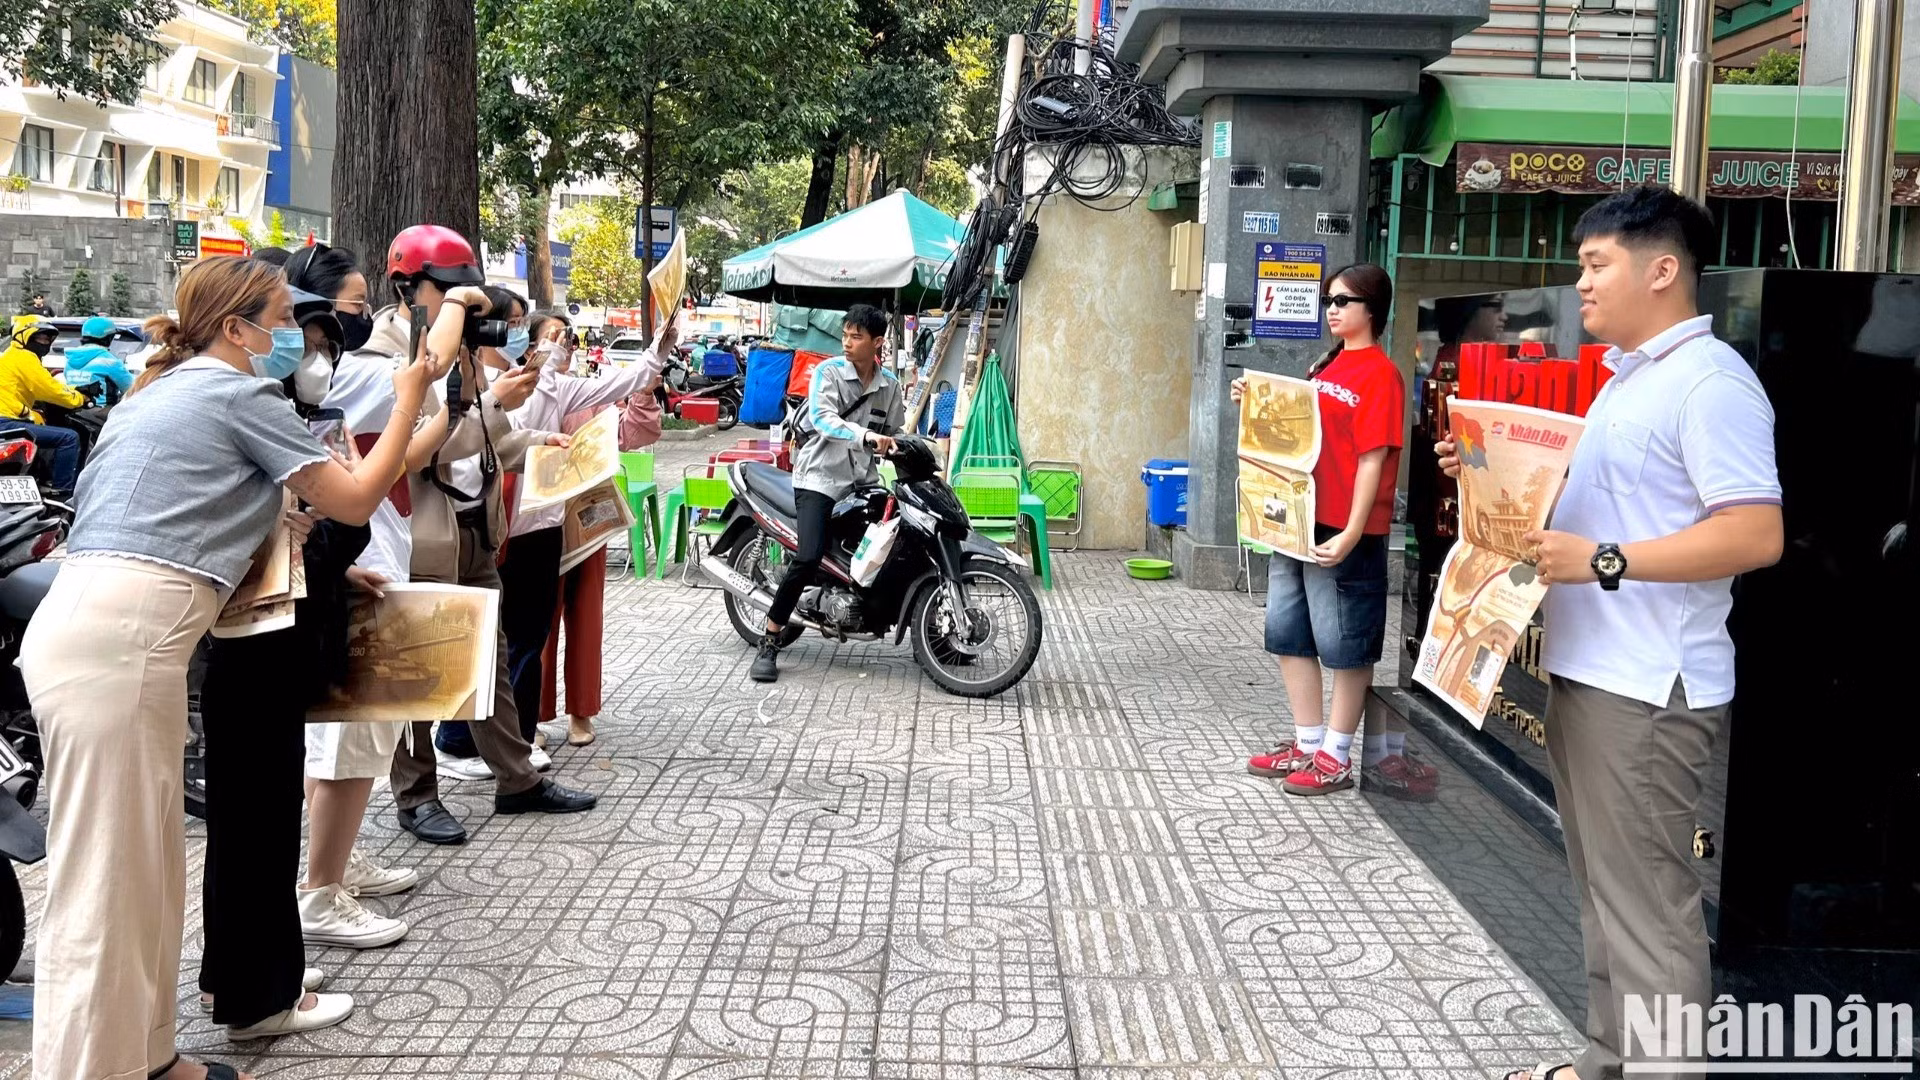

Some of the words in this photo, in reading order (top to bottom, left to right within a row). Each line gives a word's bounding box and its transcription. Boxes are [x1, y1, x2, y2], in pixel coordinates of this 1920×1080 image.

[1520, 173, 1544, 182] CAFE
[1546, 173, 1553, 182] &
[1554, 173, 1583, 184] JUICE
[1596, 156, 1673, 184] CAFE
[1713, 160, 1800, 188] JUICE
[1508, 423, 1541, 441] Nhân
[1540, 429, 1569, 447] Dân
